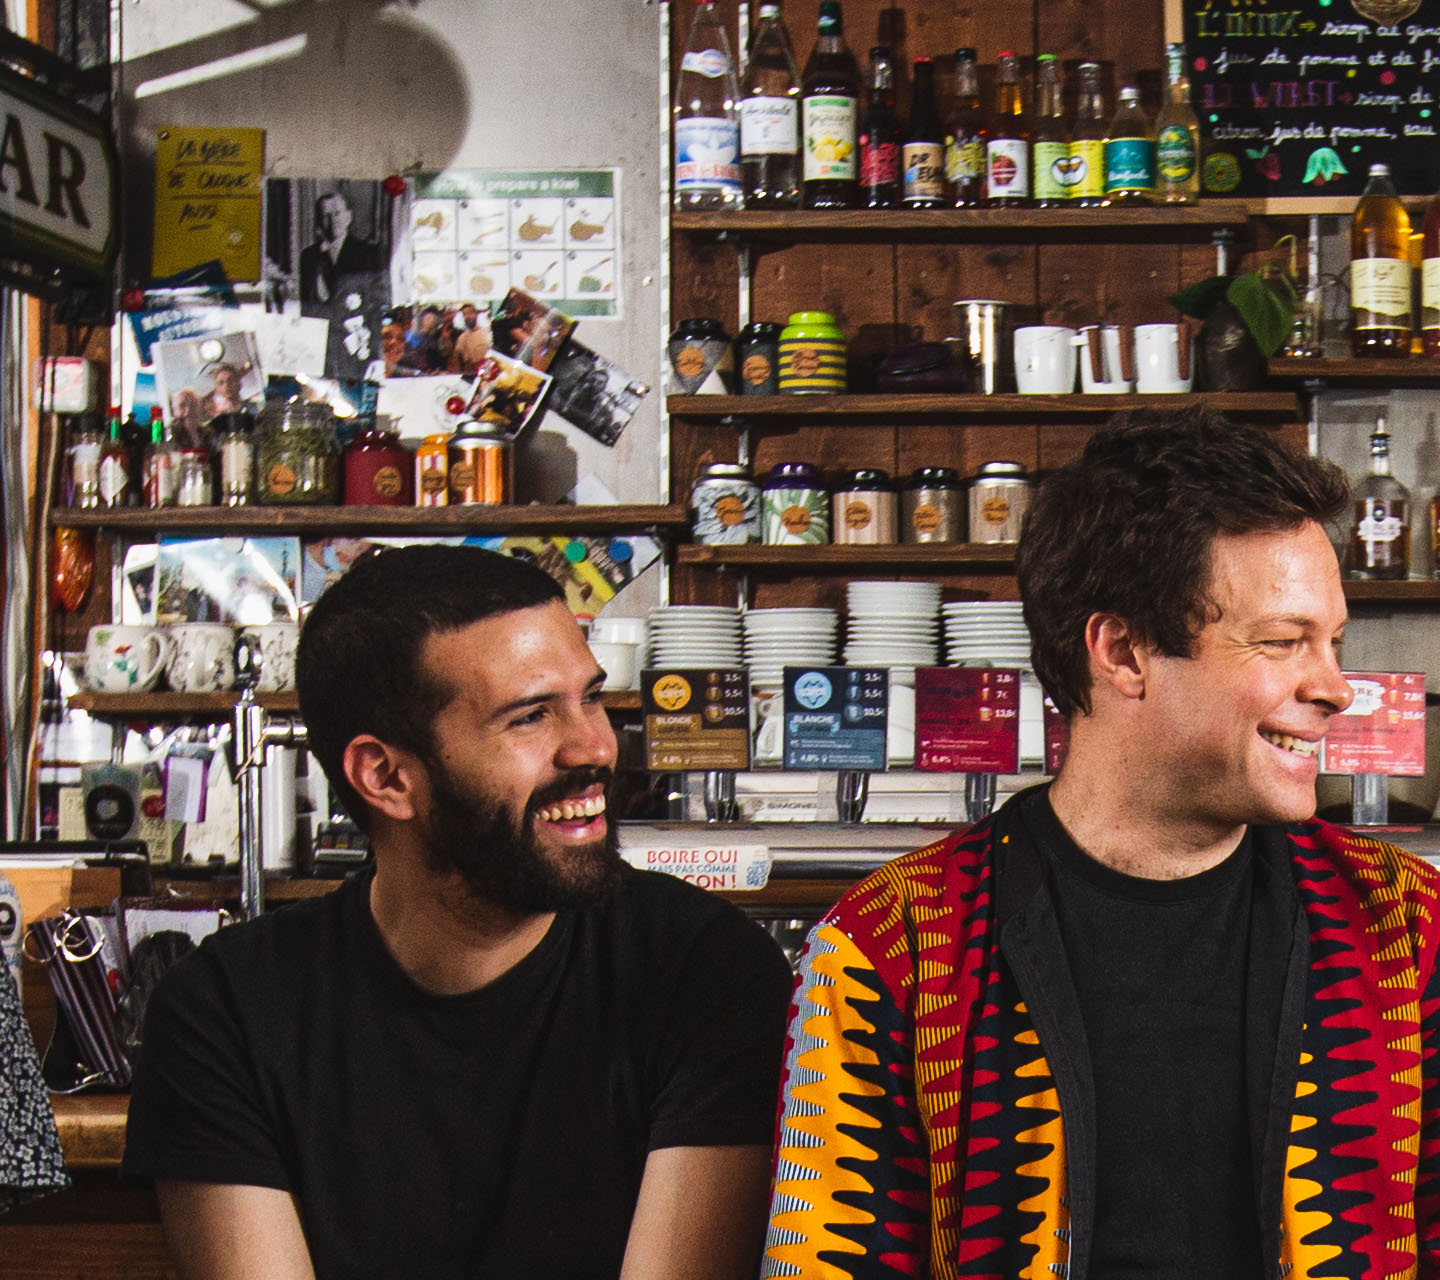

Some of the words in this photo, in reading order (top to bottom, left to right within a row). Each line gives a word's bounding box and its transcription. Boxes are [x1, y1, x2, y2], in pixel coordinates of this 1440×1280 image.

[1320, 22, 1371, 43] sirop
[1261, 47, 1290, 65] de
[1368, 51, 1386, 65] et
[1391, 51, 1415, 65] de
[1410, 85, 1433, 103] de
[1265, 121, 1302, 145] jus
[1303, 122, 1327, 138] de
[647, 850, 699, 864] BOIRE
[705, 850, 738, 864] OUI
[675, 865, 695, 873] PAS
[697, 865, 737, 873] COMME
